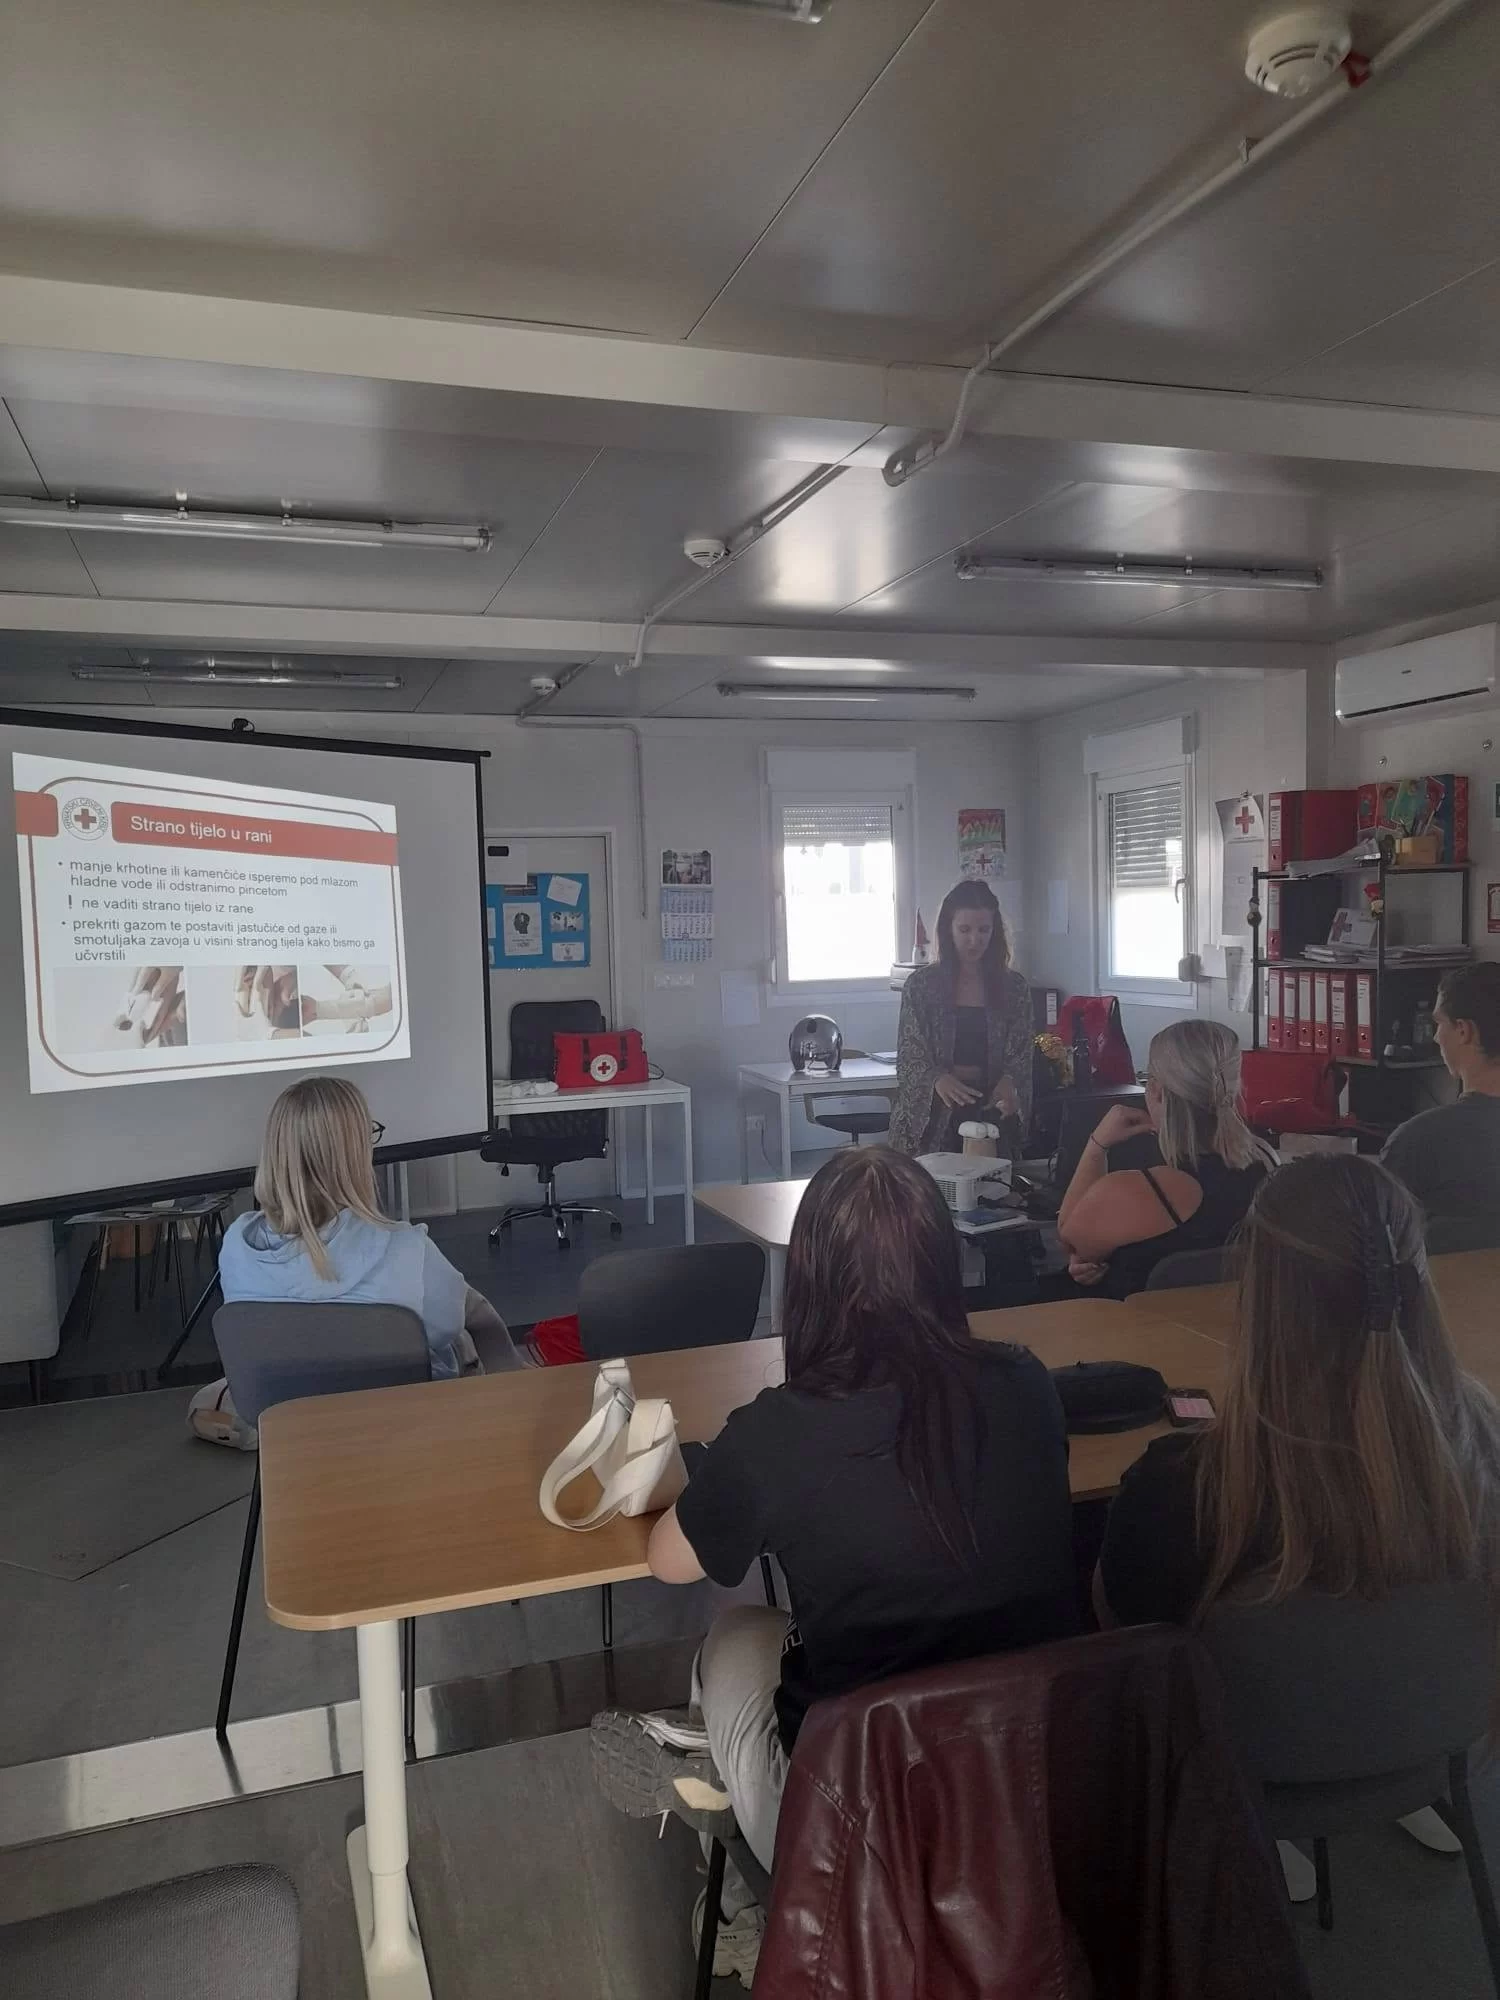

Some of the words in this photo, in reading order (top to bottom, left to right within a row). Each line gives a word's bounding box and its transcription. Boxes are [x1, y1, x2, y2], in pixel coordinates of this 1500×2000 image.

[131, 816, 185, 835] Strano
[190, 821, 226, 840] tijelo
[231, 829, 240, 840] u
[245, 829, 272, 843] rani
[70, 861, 112, 875] manje
[116, 862, 167, 876] krhotine
[171, 866, 180, 876] ili
[249, 873, 297, 884] isperemo
[300, 876, 319, 888] pod
[321, 878, 359, 888] mlazom
[71, 875, 117, 888] hladne
[121, 877, 152, 889] vode
[157, 880, 166, 891] ili
[169, 881, 235, 894] odstranimo
[238, 885, 287, 897] pincetom
[68, 894, 73, 909] !
[82, 899, 99, 909] ne
[104, 899, 138, 910] vaditi
[142, 900, 181, 912] strano
[184, 901, 212, 914] tijelo
[215, 903, 225, 913] iz
[228, 904, 254, 914] rane
[73, 918, 120, 932] prekriti
[124, 922, 167, 933] gazom
[170, 921, 182, 931] te
[186, 922, 234, 932] postaviti
[287, 923, 300, 933] od
[303, 925, 327, 936] gaze
[330, 924, 338, 934] ili
[74, 935, 146, 948] smotuljaka
[150, 935, 190, 948] zavoja
[194, 936, 201, 946] u
[204, 936, 233, 947] visini
[236, 937, 278, 950] stranog
[280, 937, 305, 949] tijela
[307, 937, 331, 948] kako
[333, 938, 361, 948] bismo
[363, 939, 376, 950] ga
[75, 950, 126, 961] učvrstili
